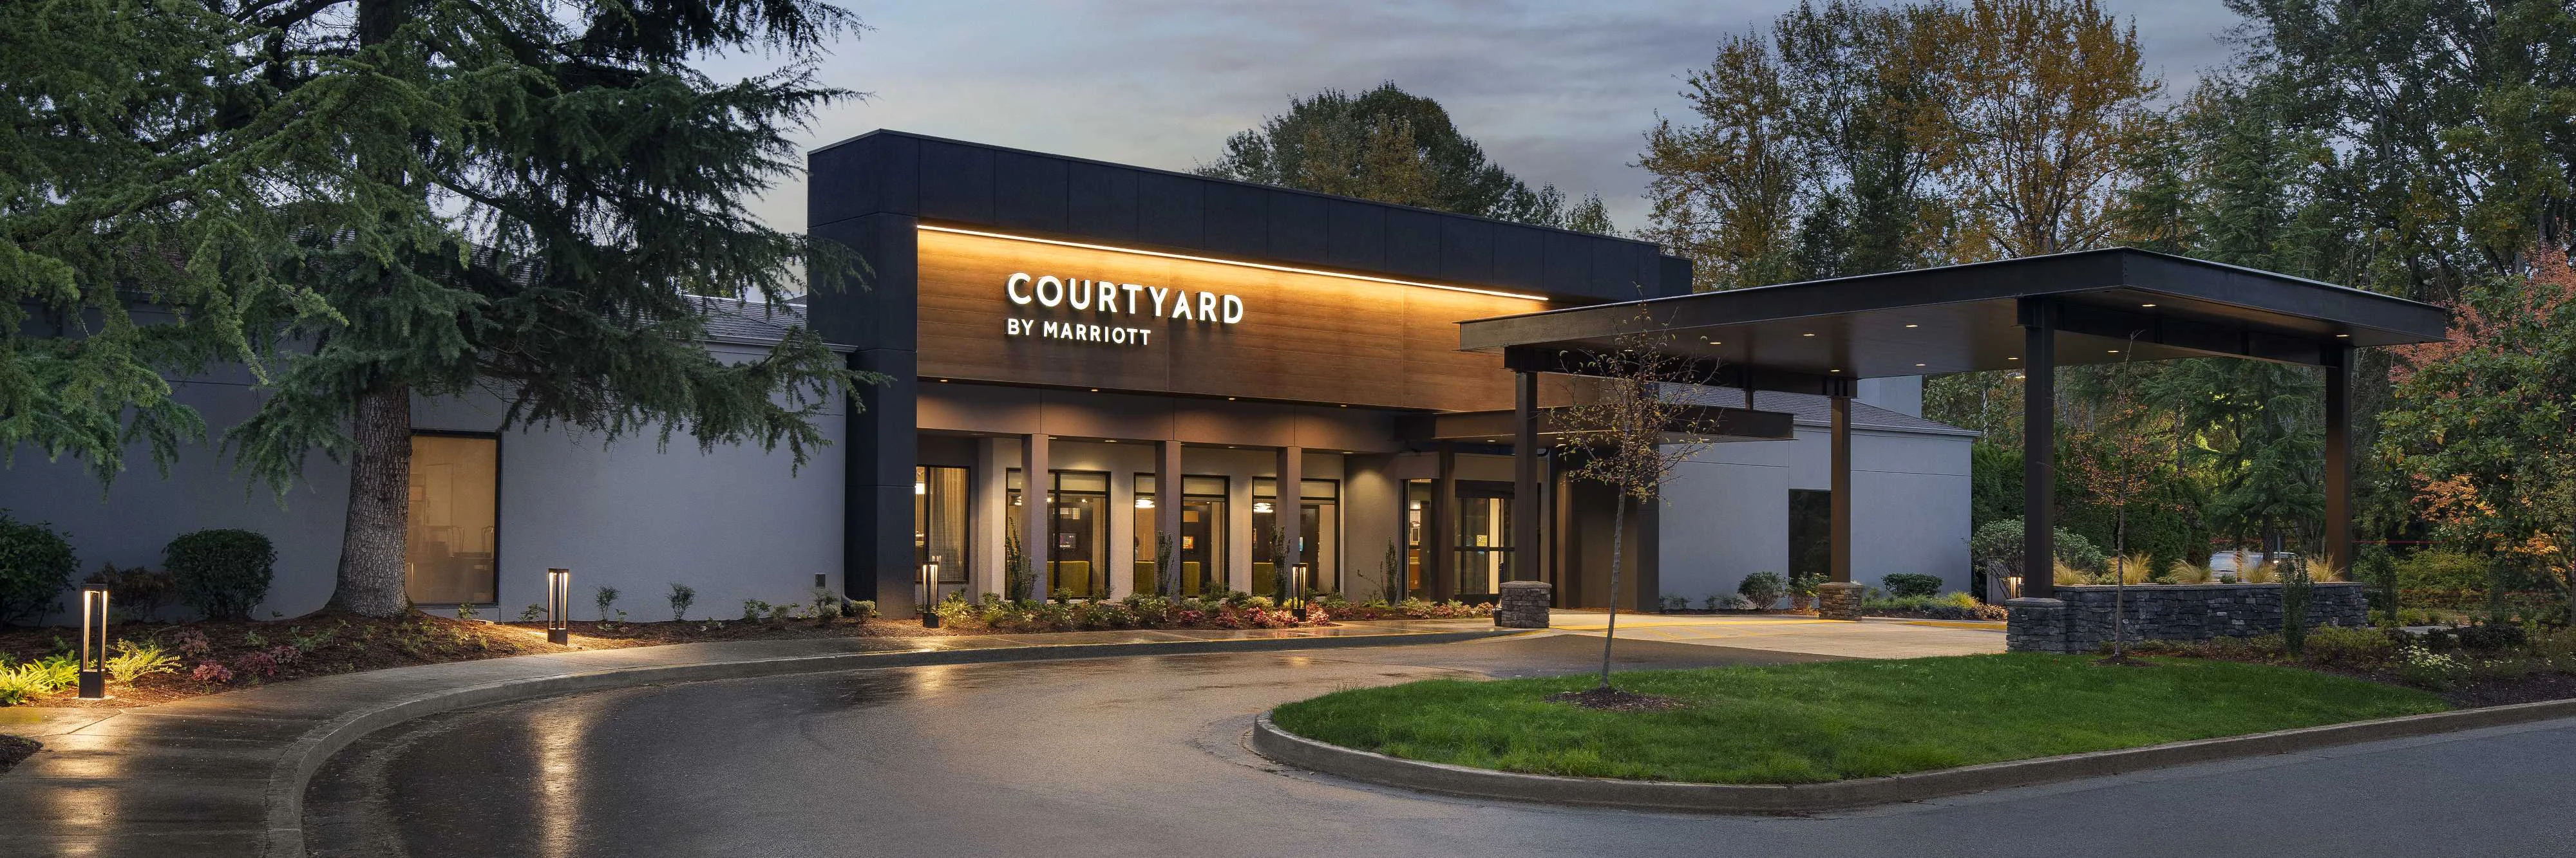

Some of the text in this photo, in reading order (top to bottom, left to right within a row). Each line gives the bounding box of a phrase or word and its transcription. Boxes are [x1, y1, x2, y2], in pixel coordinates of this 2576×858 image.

[1006, 272, 1244, 324] COURTYARD
[1007, 318, 1151, 346] BY MARRIOTT
